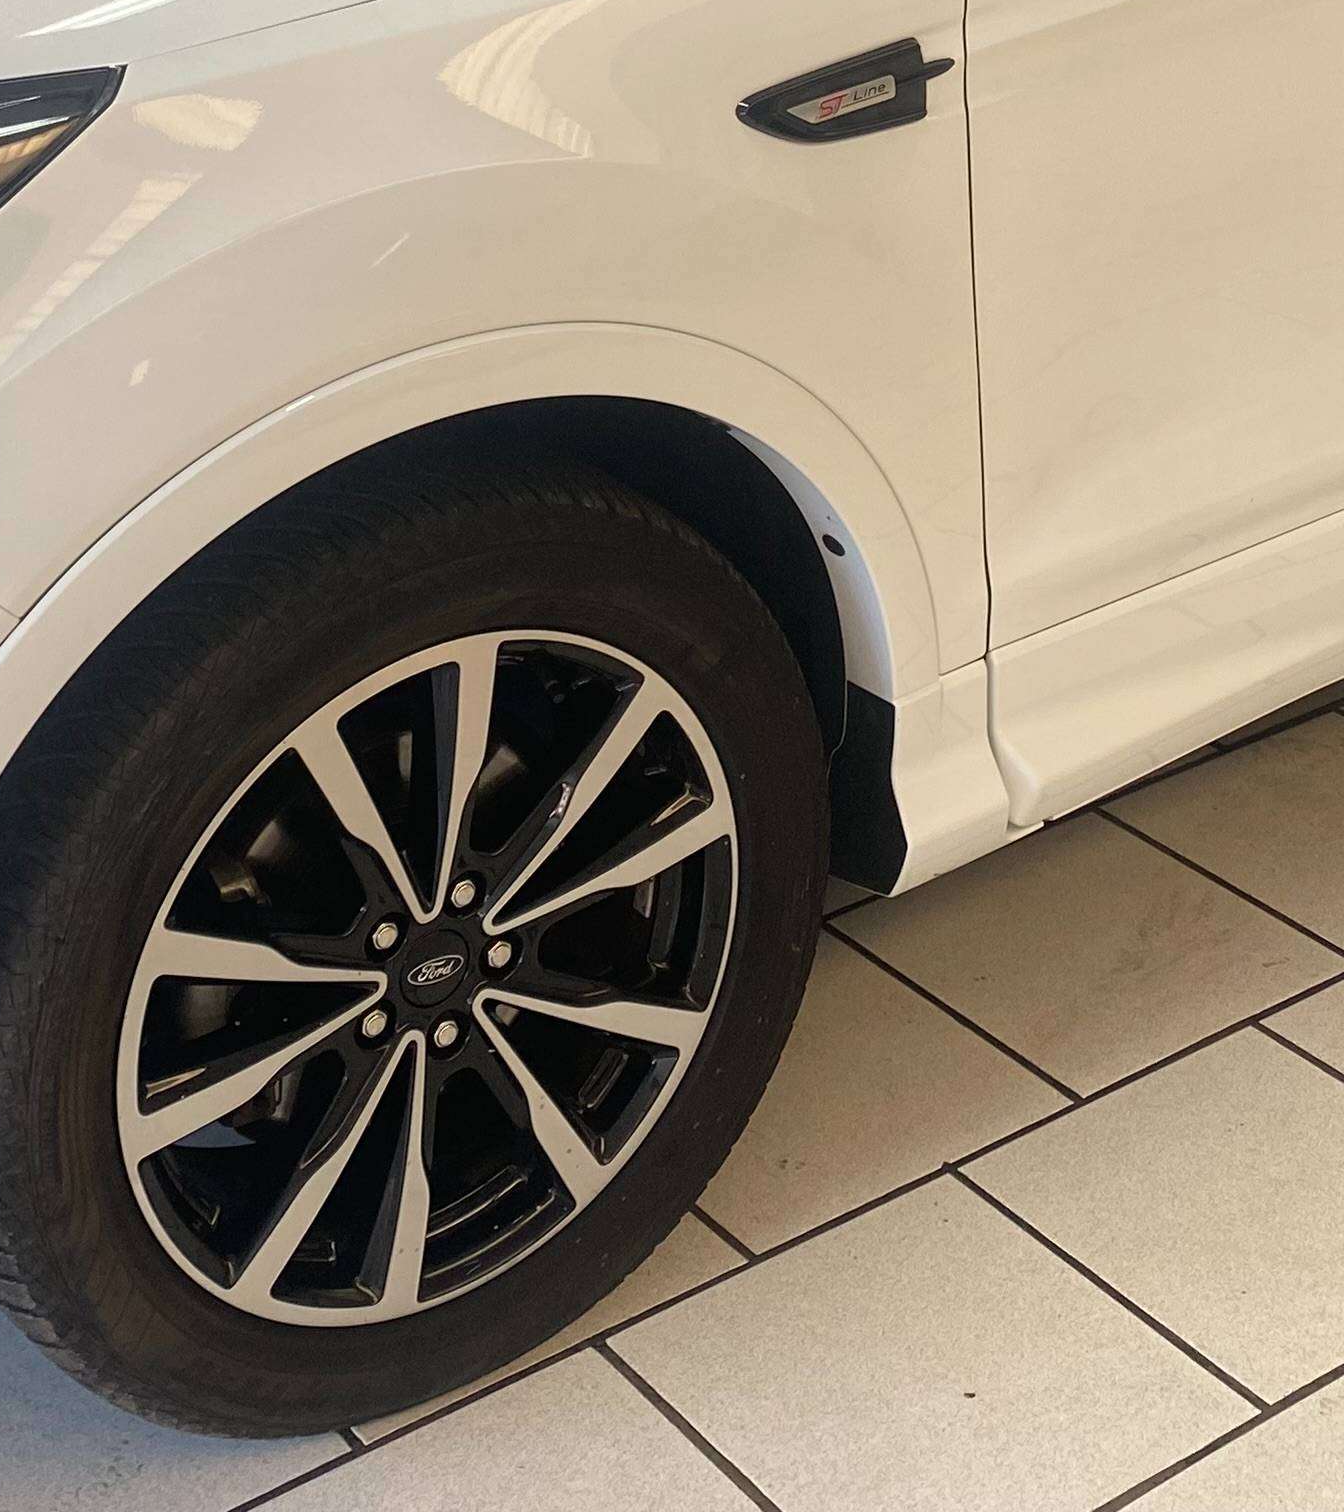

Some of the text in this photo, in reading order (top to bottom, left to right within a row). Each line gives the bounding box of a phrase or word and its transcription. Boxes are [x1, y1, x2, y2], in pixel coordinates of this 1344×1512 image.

[817, 83, 886, 119] ST Line
[417, 960, 455, 982] Ford
